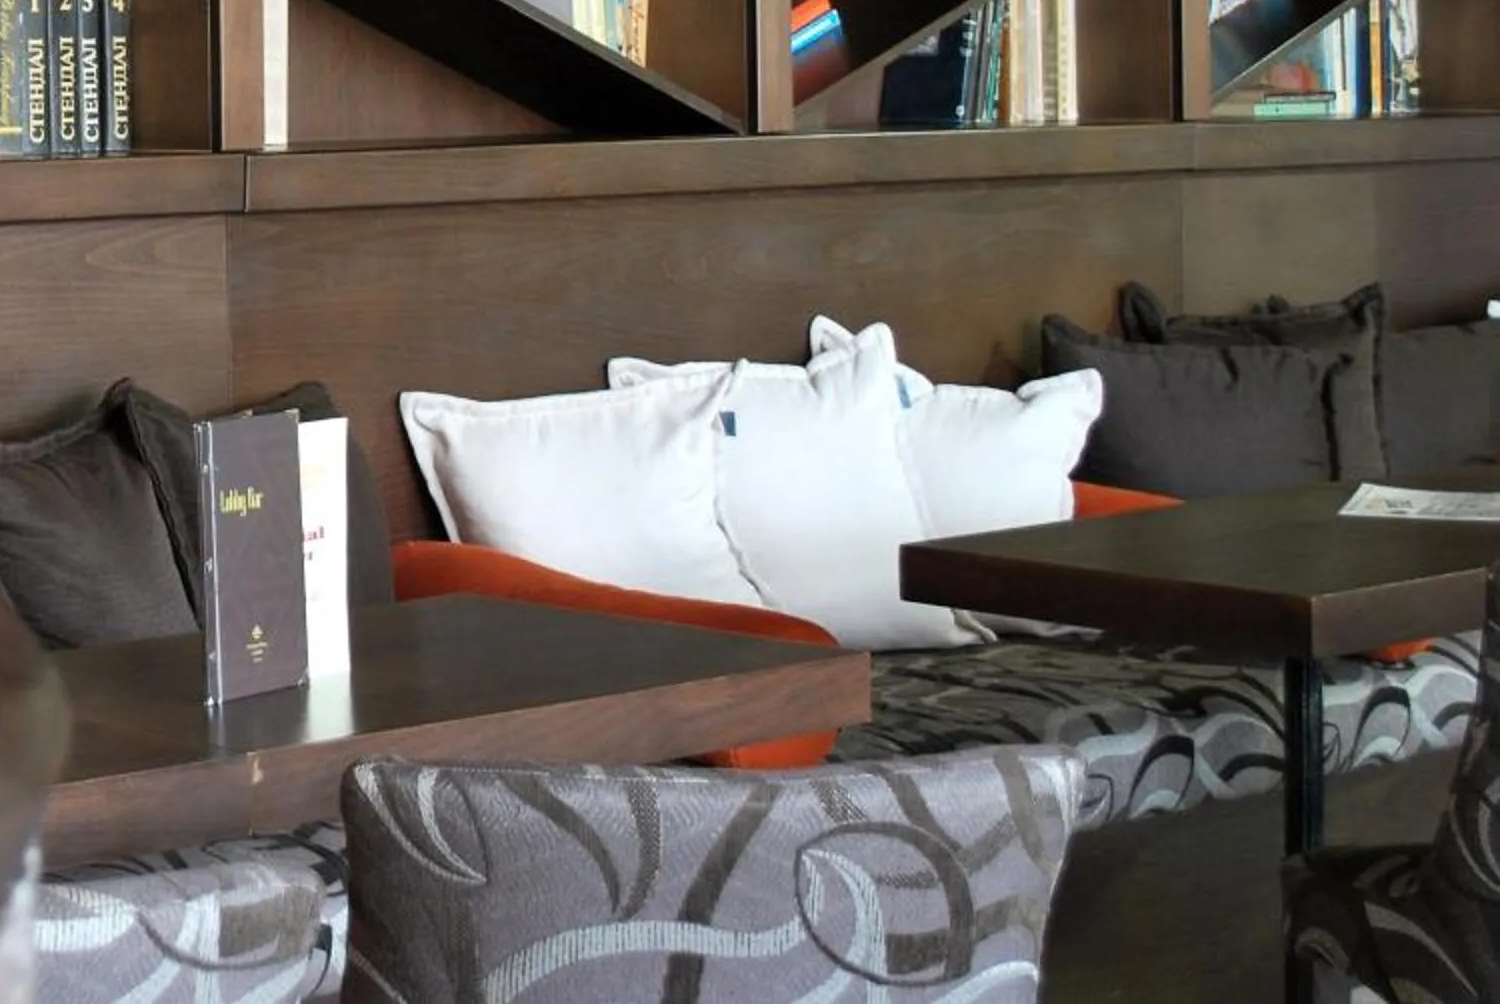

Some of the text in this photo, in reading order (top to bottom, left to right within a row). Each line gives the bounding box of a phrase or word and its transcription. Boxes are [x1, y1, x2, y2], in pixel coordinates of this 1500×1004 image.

[27, 37, 46, 144] СТЕНДАЛ
[59, 35, 75, 141] СТЕНДАЛ
[81, 37, 99, 143] СТЕНДАЛ
[112, 35, 129, 139] СТЕНДАЛ
